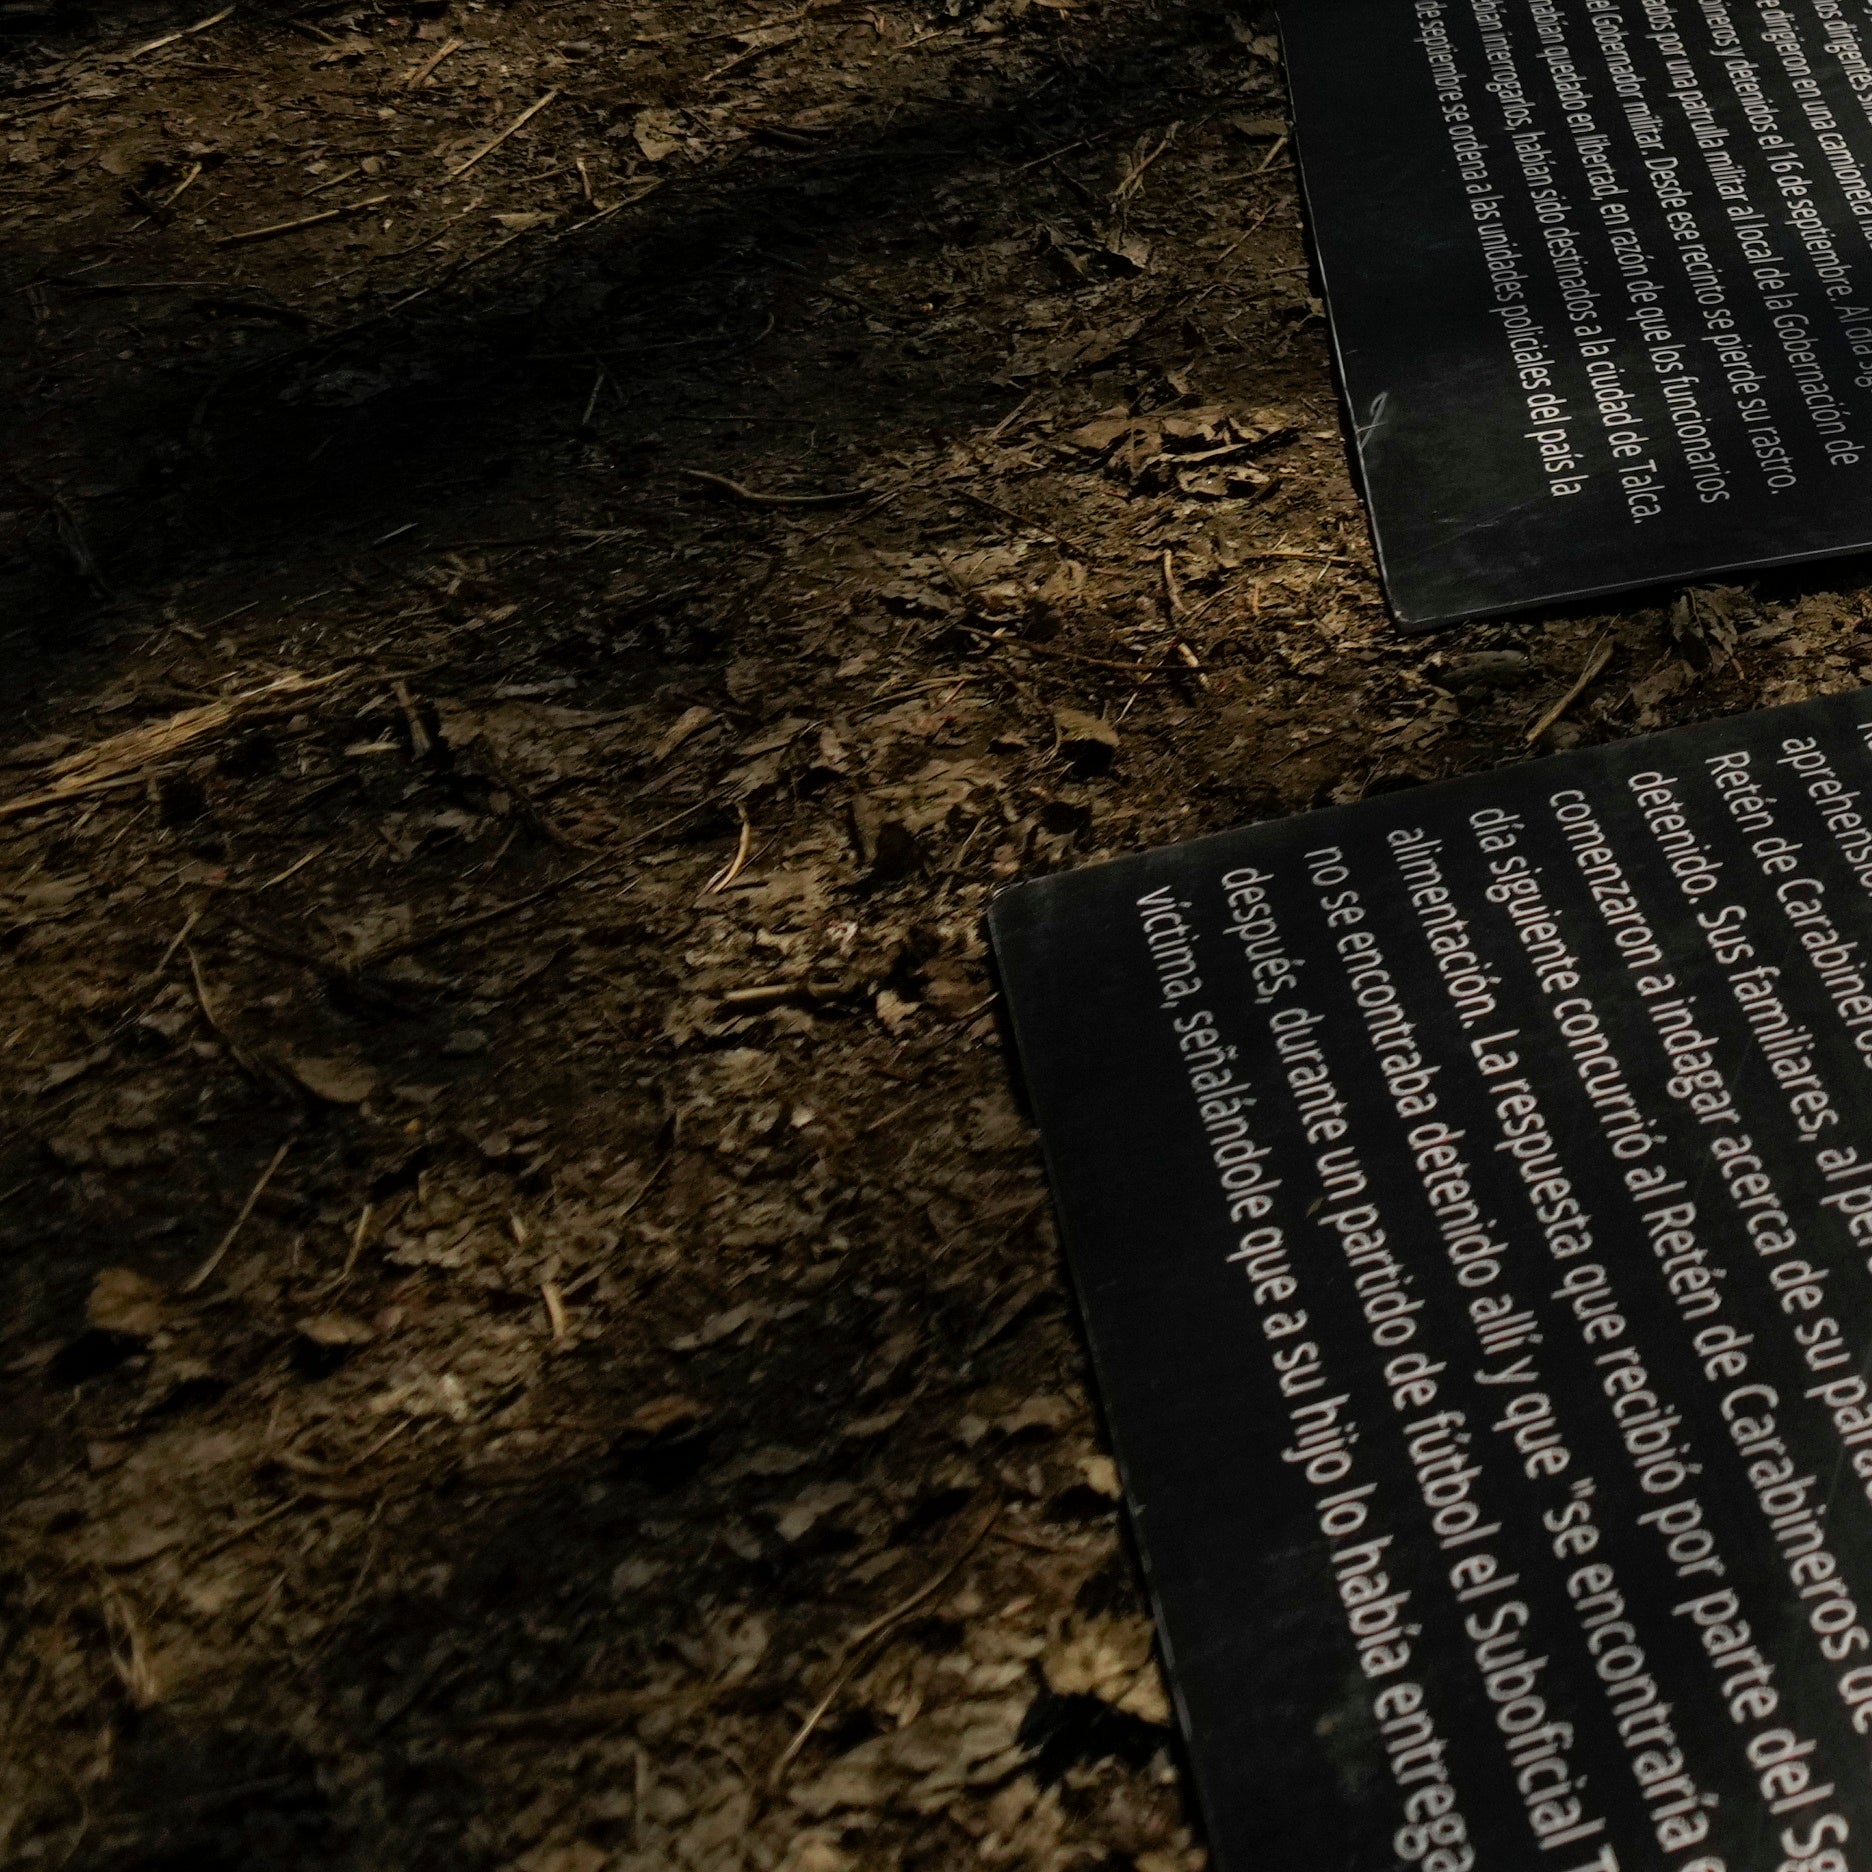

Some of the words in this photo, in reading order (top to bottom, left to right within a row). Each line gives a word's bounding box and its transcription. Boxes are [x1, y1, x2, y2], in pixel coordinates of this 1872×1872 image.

[1469, 808, 1525, 853] día
[1705, 751, 1777, 833] Retén
[1752, 837, 1803, 875] de
[1136, 885, 1202, 1009] víctima,
[1486, 856, 1580, 993] siguiente
[1173, 1010, 1282, 1222] señalándole
[1553, 998, 1667, 1159] concurrió
[1624, 1165, 1687, 1201] al
[1226, 1226, 1297, 1305] que
[1642, 1202, 1727, 1320] Retén
[1262, 1309, 1308, 1340] a
[1272, 1341, 1326, 1397] su
[1693, 1325, 1754, 1381] de
[1281, 1394, 1359, 1484] hijo
[1315, 1483, 1377, 1536] lo
[1721, 1384, 1869, 1659] Carabineros
[1331, 1535, 1422, 1678] había
